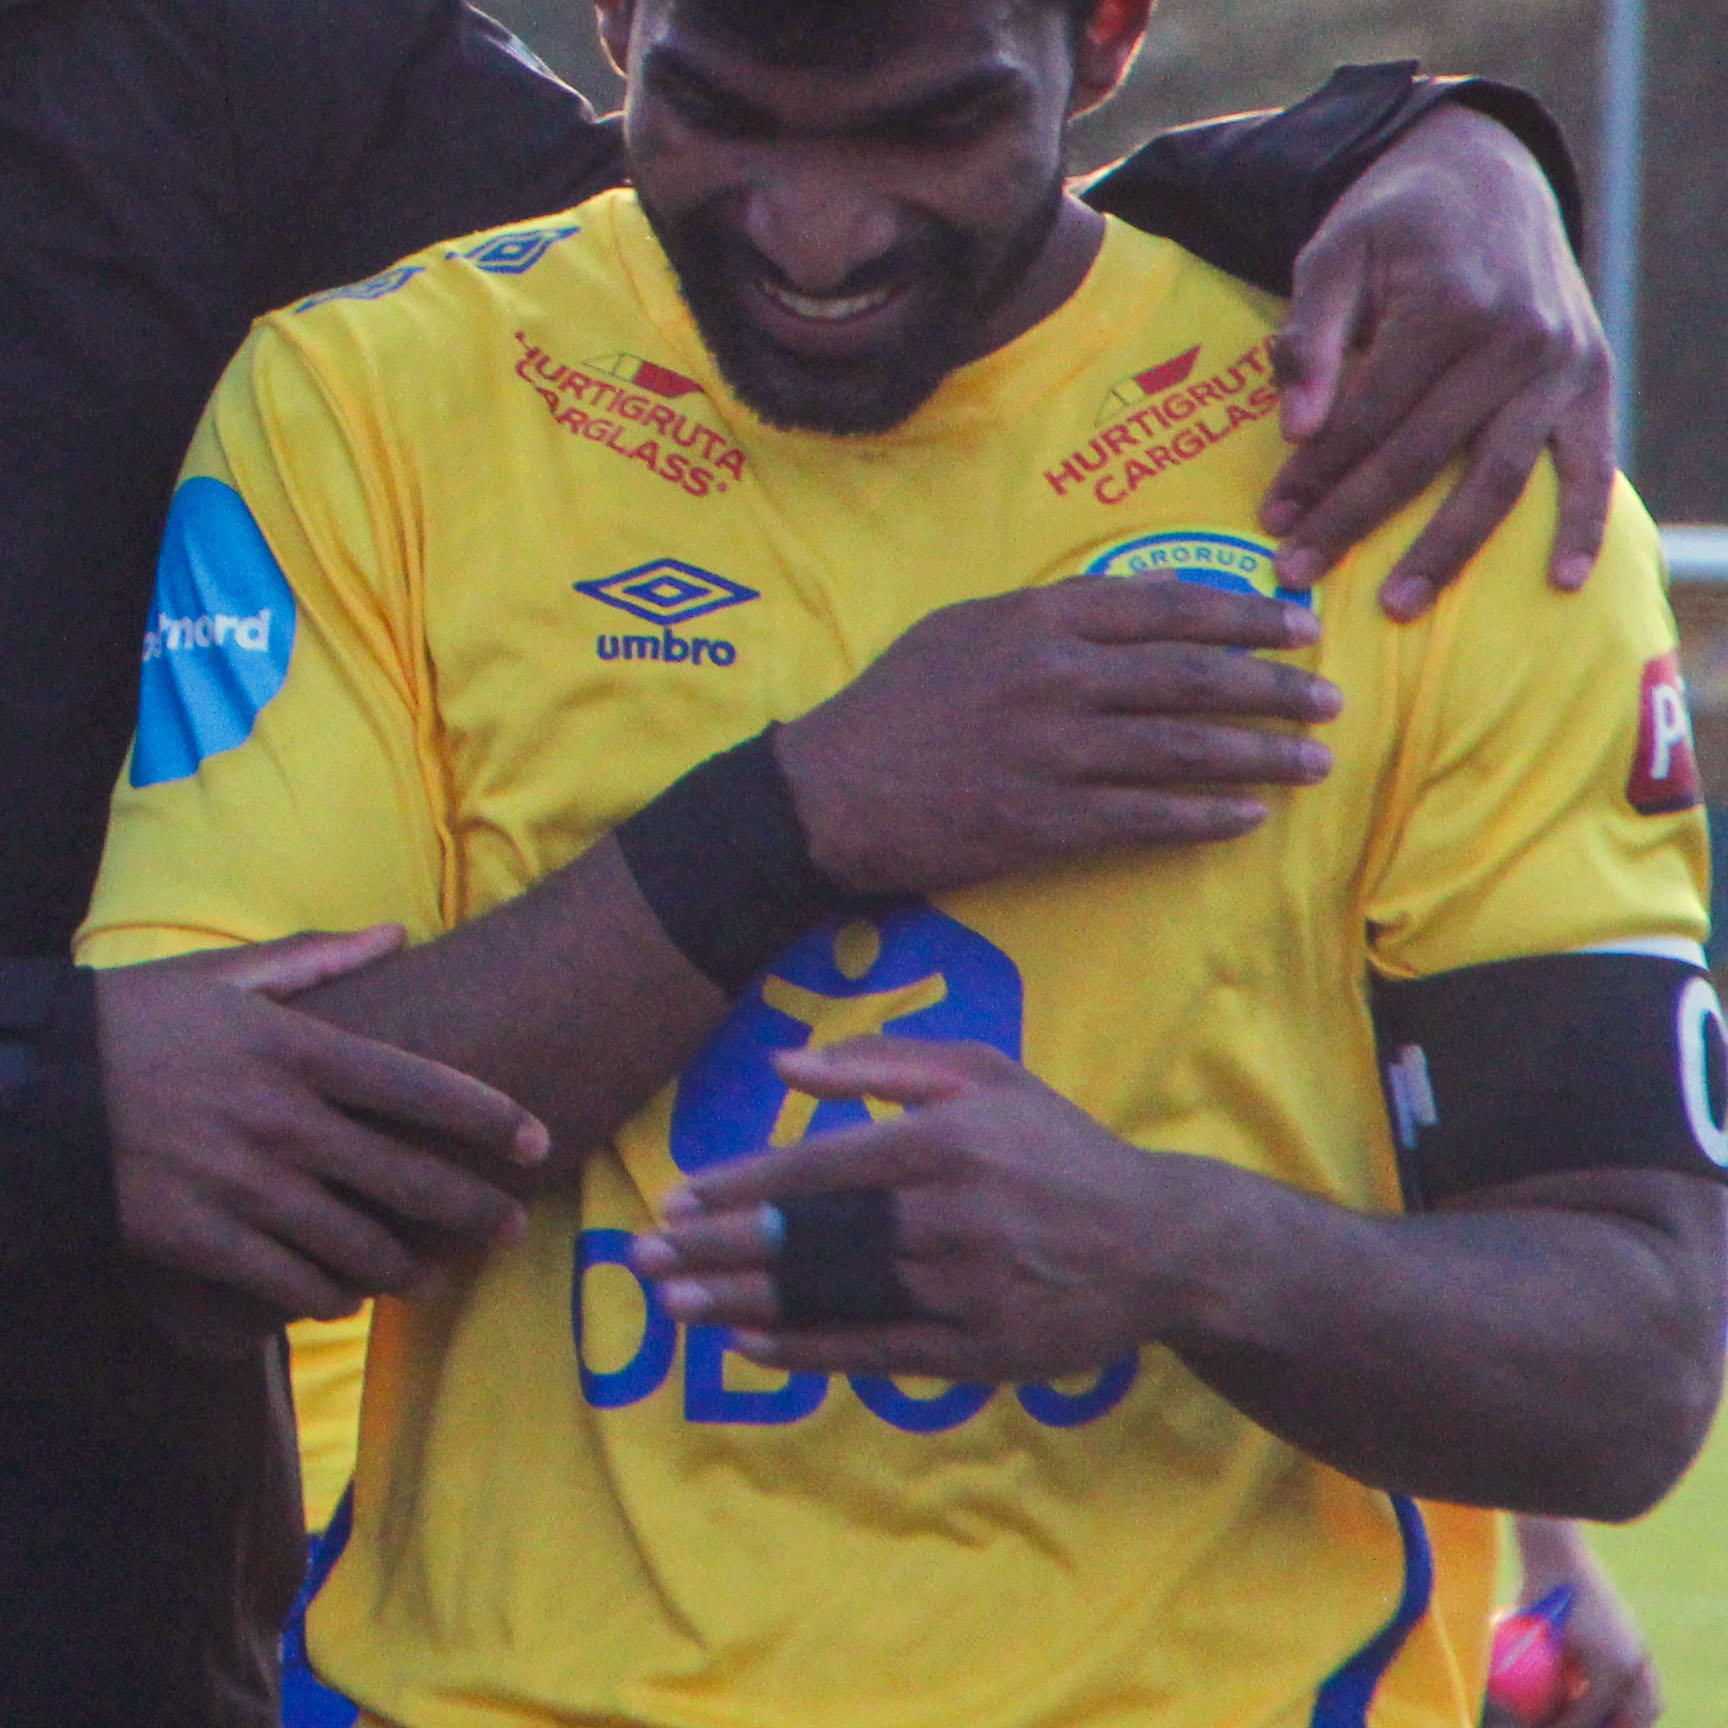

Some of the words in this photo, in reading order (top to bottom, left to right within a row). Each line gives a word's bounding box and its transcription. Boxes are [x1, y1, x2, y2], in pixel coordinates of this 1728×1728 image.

[1093, 384, 1281, 505] CARGLAS
[1127, 545, 1260, 574] GRORUD
[595, 627, 737, 668] umbro
